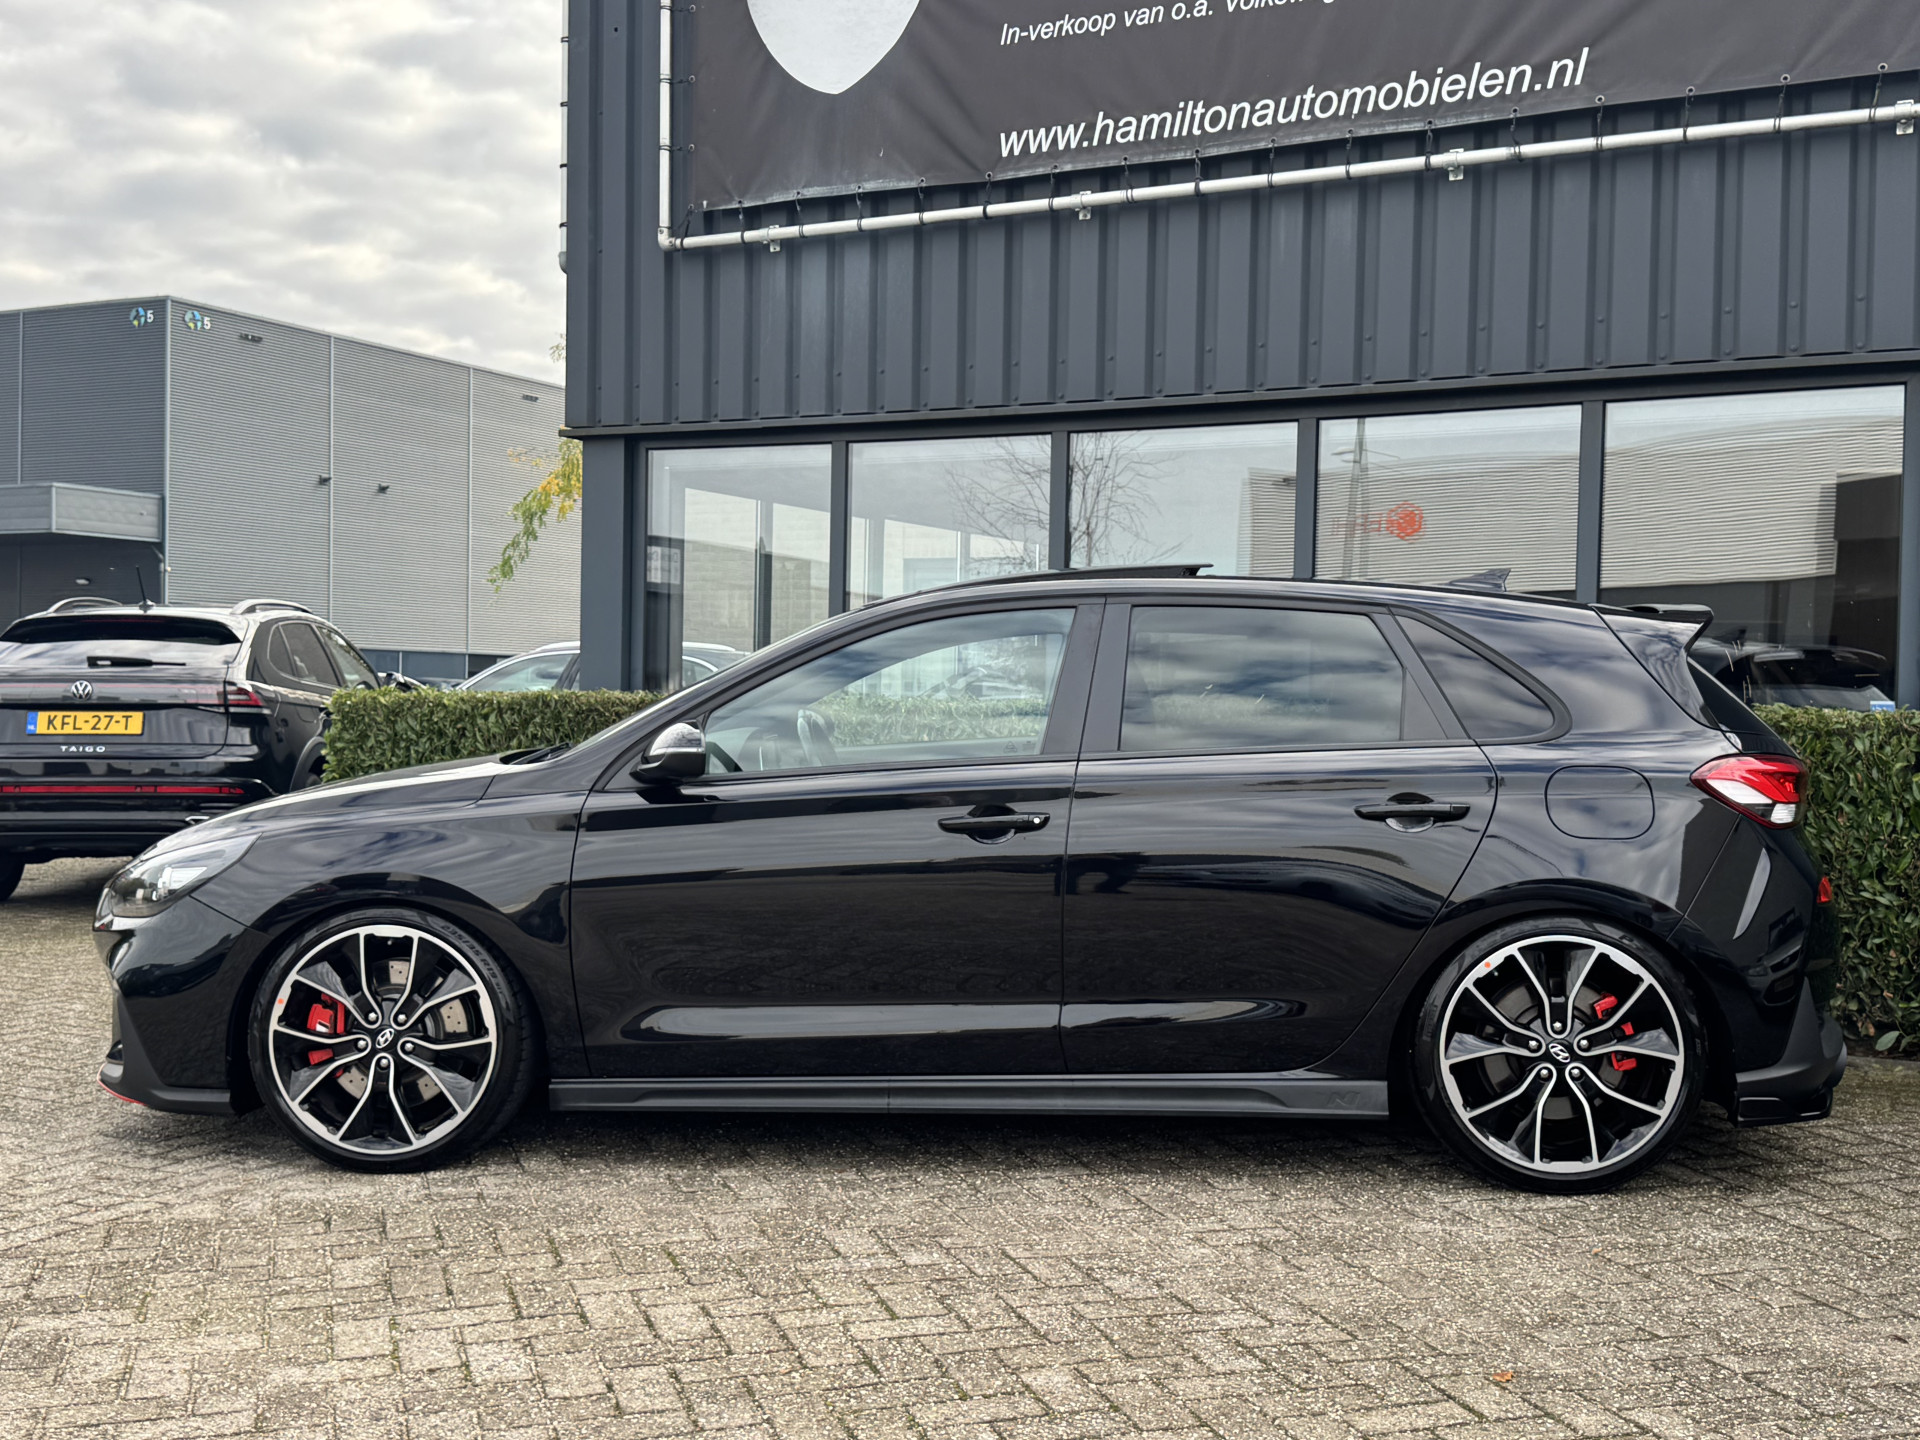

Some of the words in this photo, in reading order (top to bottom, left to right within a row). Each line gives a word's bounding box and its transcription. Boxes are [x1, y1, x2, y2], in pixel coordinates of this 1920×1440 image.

[1000, 13, 1116, 46] In-verkoop
[1124, 5, 1165, 27] van
[1171, 0, 1213, 20] o.a.
[1000, 47, 1590, 158] www.hamiltonautomobielen.nl
[146, 309, 154, 323] 5
[203, 316, 211, 330] 5
[46, 714, 133, 731] KFL-27-T
[60, 745, 106, 753] TAIGO
